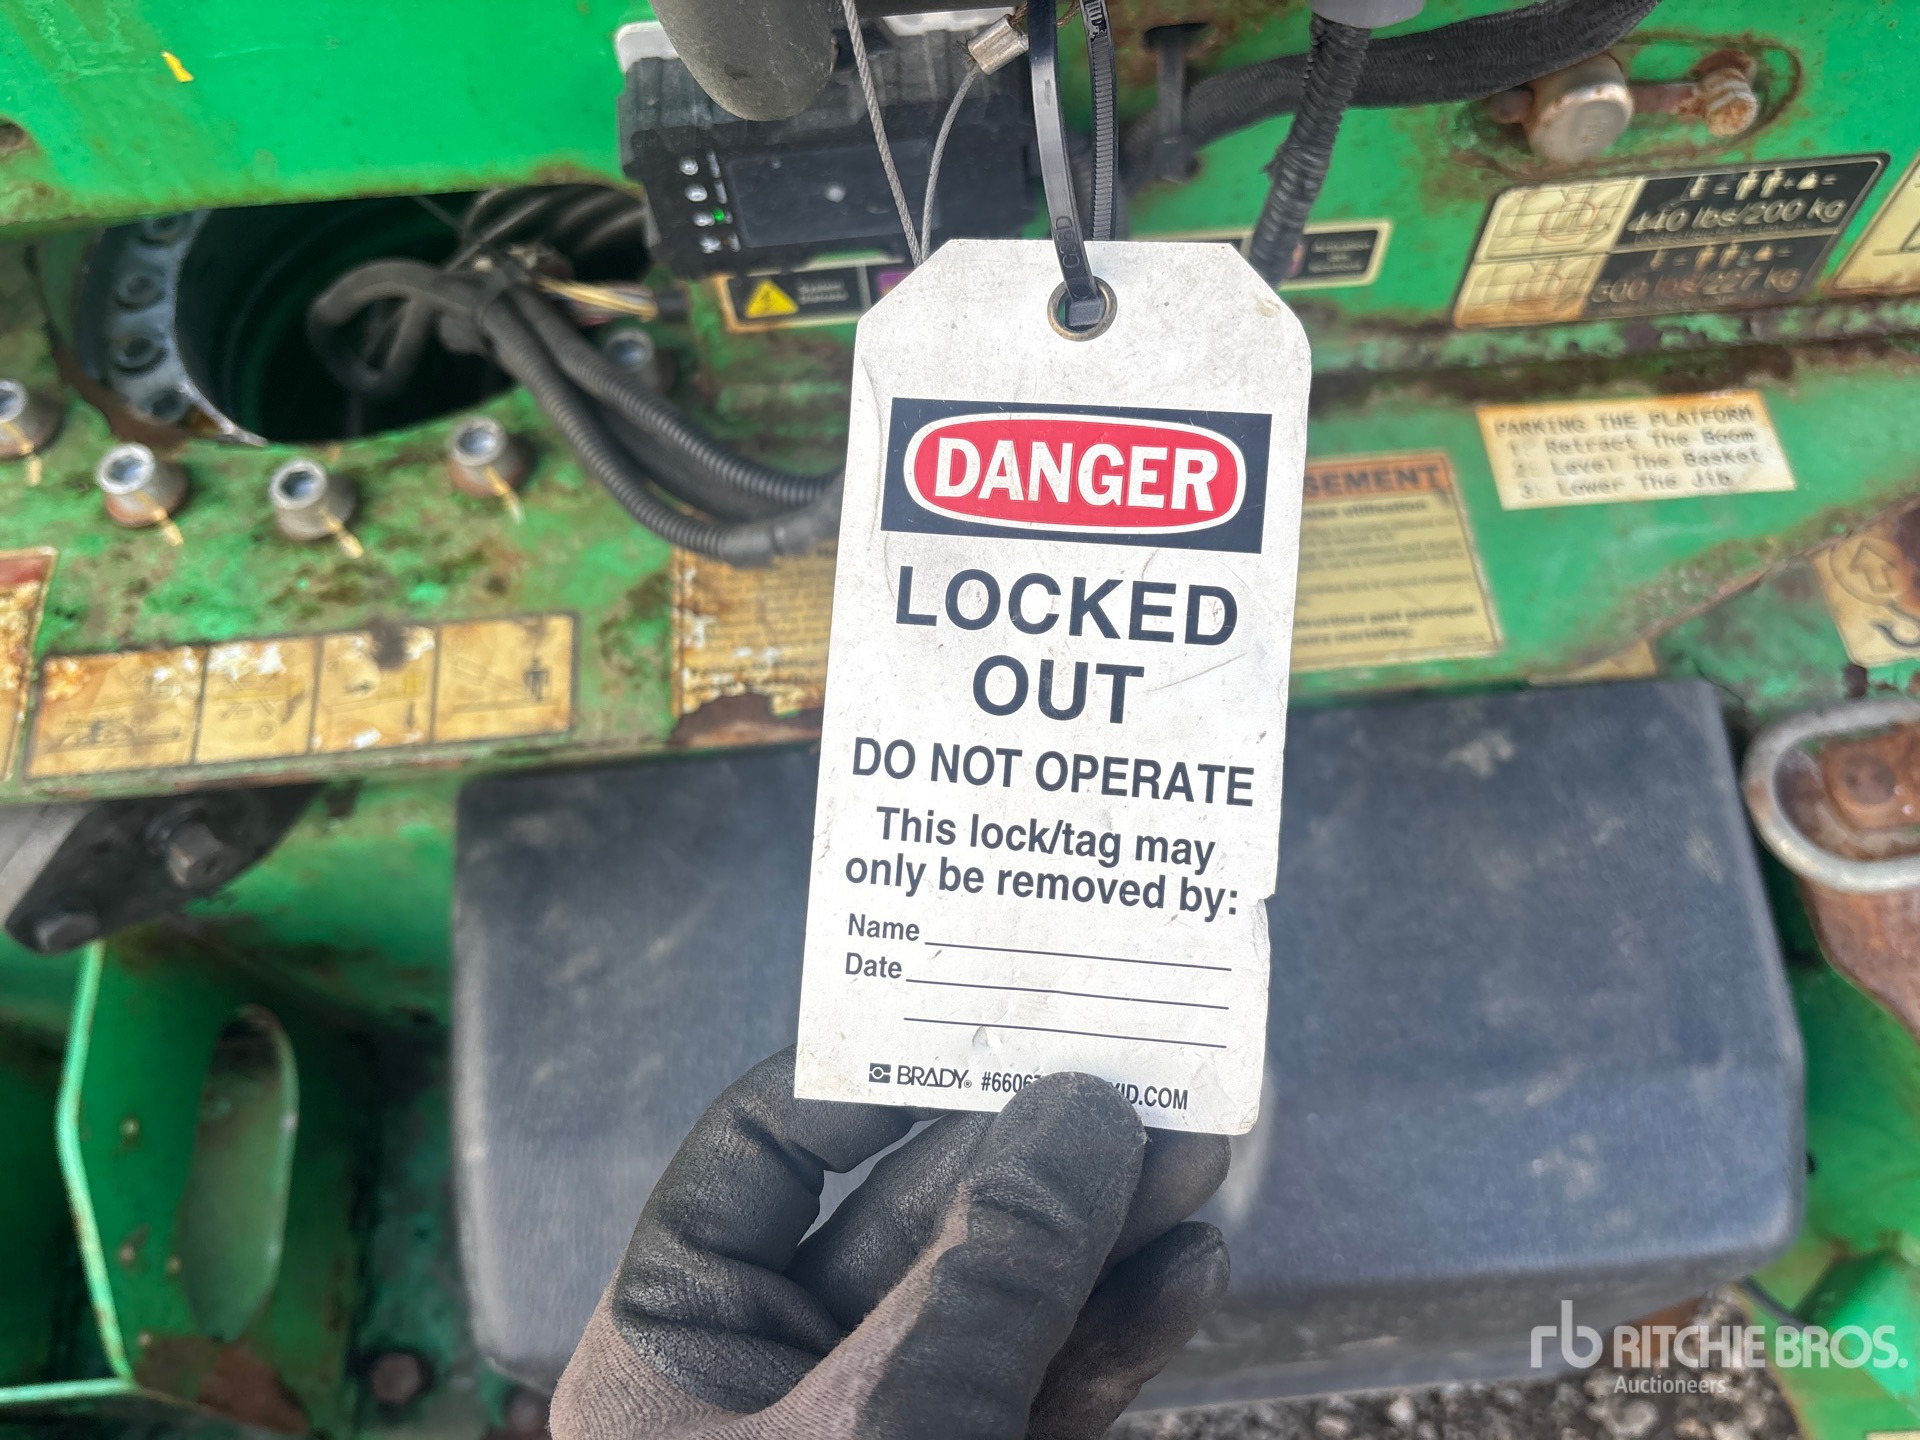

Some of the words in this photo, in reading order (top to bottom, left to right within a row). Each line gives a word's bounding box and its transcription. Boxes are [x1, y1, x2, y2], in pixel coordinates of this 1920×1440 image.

[1627, 208, 1690, 233] 440
[1494, 416, 1586, 438] PARKING
[1595, 411, 1639, 431] THE
[1648, 404, 1756, 427] PLATFORM
[934, 437, 1220, 512] DANGER
[896, 566, 1238, 646] LOCKED
[973, 655, 1144, 724] OUT
[852, 737, 916, 779] DO
[931, 742, 1022, 788] NOT
[1035, 751, 1255, 807] OPERATE
[877, 806, 956, 846] This
[970, 814, 1121, 868] lock/tag
[1135, 835, 1215, 875] may
[845, 853, 926, 897] only
[939, 857, 984, 894] be
[997, 868, 1165, 909] removed
[1179, 877, 1238, 922] by:
[848, 913, 920, 942] Name
[845, 952, 902, 979] Date
[981, 1071, 1041, 1093] #6606
[1112, 1082, 1188, 1110] ID.COM
